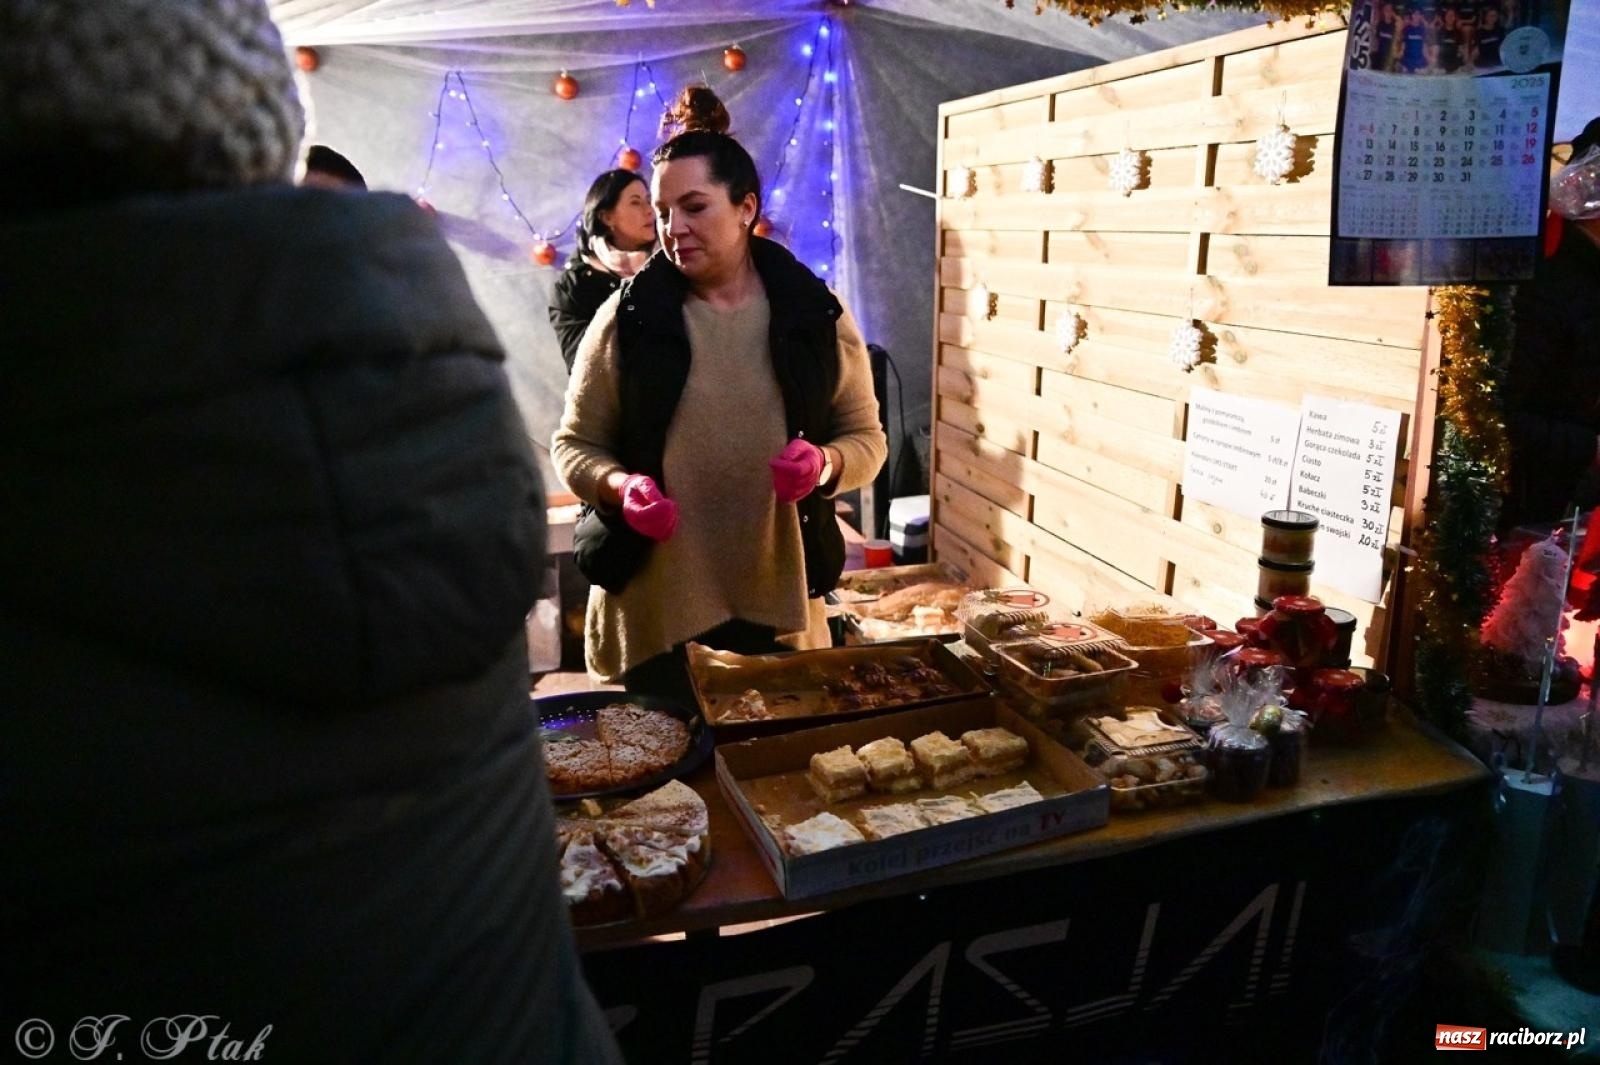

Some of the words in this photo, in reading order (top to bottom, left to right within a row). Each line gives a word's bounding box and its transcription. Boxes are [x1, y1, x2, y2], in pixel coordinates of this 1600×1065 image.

[1511, 77, 1545, 90] 2025
[1440, 110, 1448, 121] 2
[1468, 109, 1476, 120] 3
[1500, 108, 1507, 120] 4
[1391, 124, 1398, 135] 7
[1413, 125, 1420, 136] 8
[1440, 124, 1446, 137] 9
[1464, 125, 1476, 136] 10
[1495, 124, 1504, 136] 11
[1526, 121, 1538, 134] 12
[1366, 138, 1374, 150] 13
[1388, 138, 1396, 151] 14
[1410, 140, 1420, 152] 15
[1436, 140, 1446, 152] 16
[1464, 140, 1474, 152] 17
[1494, 138, 1504, 150] 18
[1524, 136, 1536, 148] 19
[1364, 154, 1374, 165] 20
[1386, 154, 1396, 166] 21
[1408, 156, 1418, 168] 22
[1432, 156, 1446, 168] 23
[1460, 156, 1472, 168] 24
[1490, 154, 1504, 166] 25
[1521, 153, 1536, 166] 26
[1362, 170, 1372, 182] 27
[1408, 170, 1418, 183] 29
[1432, 171, 1445, 183] 30
[1460, 172, 1471, 183] 31
[1309, 410, 1328, 421] Kawa
[1306, 425, 1333, 438] Herbata
[1333, 432, 1361, 445] zimowa
[1302, 454, 1322, 467] Ciasto
[1327, 446, 1361, 461] czekolada
[1299, 470, 1321, 482] Kołacz
[1298, 484, 1327, 500] Babeczki
[1297, 500, 1320, 512] Kruche
[1320, 507, 1355, 525] ciasteczka
[1326, 526, 1351, 539] swojski
[917, 831, 999, 865] przejść
[1006, 823, 1032, 841] na
[1040, 809, 1066, 831] TV
